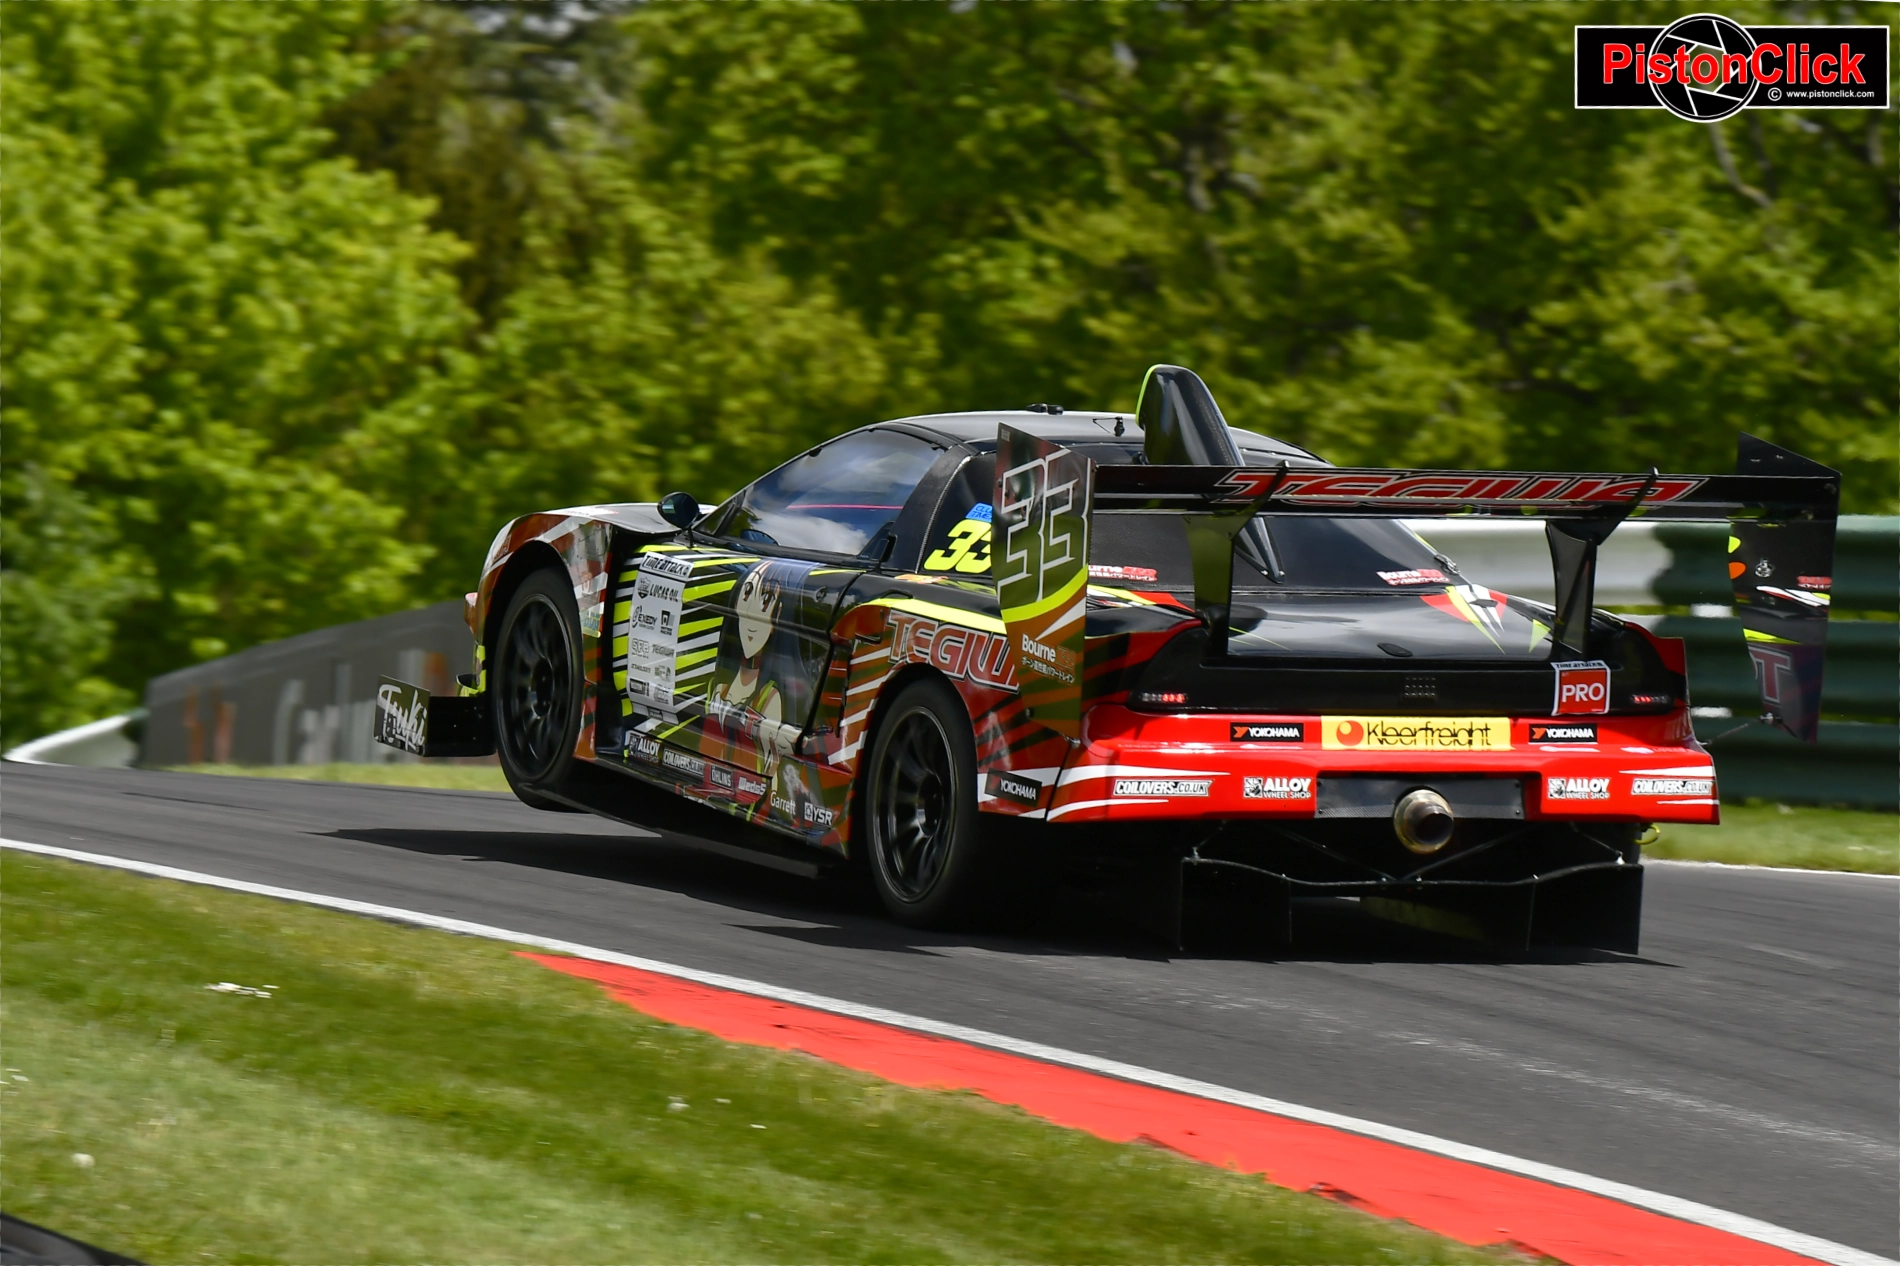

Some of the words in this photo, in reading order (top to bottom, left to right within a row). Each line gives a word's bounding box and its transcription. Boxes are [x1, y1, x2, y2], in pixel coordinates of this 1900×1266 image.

[924, 519, 992, 574] 33
[638, 613, 657, 626] EXEDY
[1022, 633, 1056, 663] Bourne
[1562, 683, 1604, 702] PRO
[1248, 727, 1300, 738] YOKOHAMA
[1366, 721, 1491, 747] Kleerfreight
[1546, 727, 1595, 738] YOKOHAMA
[638, 738, 660, 756] ALLOY
[711, 764, 732, 787] ÖHLINS
[1000, 777, 1036, 800] YOKOHAMA
[1116, 780, 1206, 795] COILOVERS.CO.UK
[1264, 778, 1312, 792] ALLOY
[1566, 778, 1611, 792] ALLOY
[770, 792, 796, 815] Garrett
[813, 807, 833, 825] YSR
